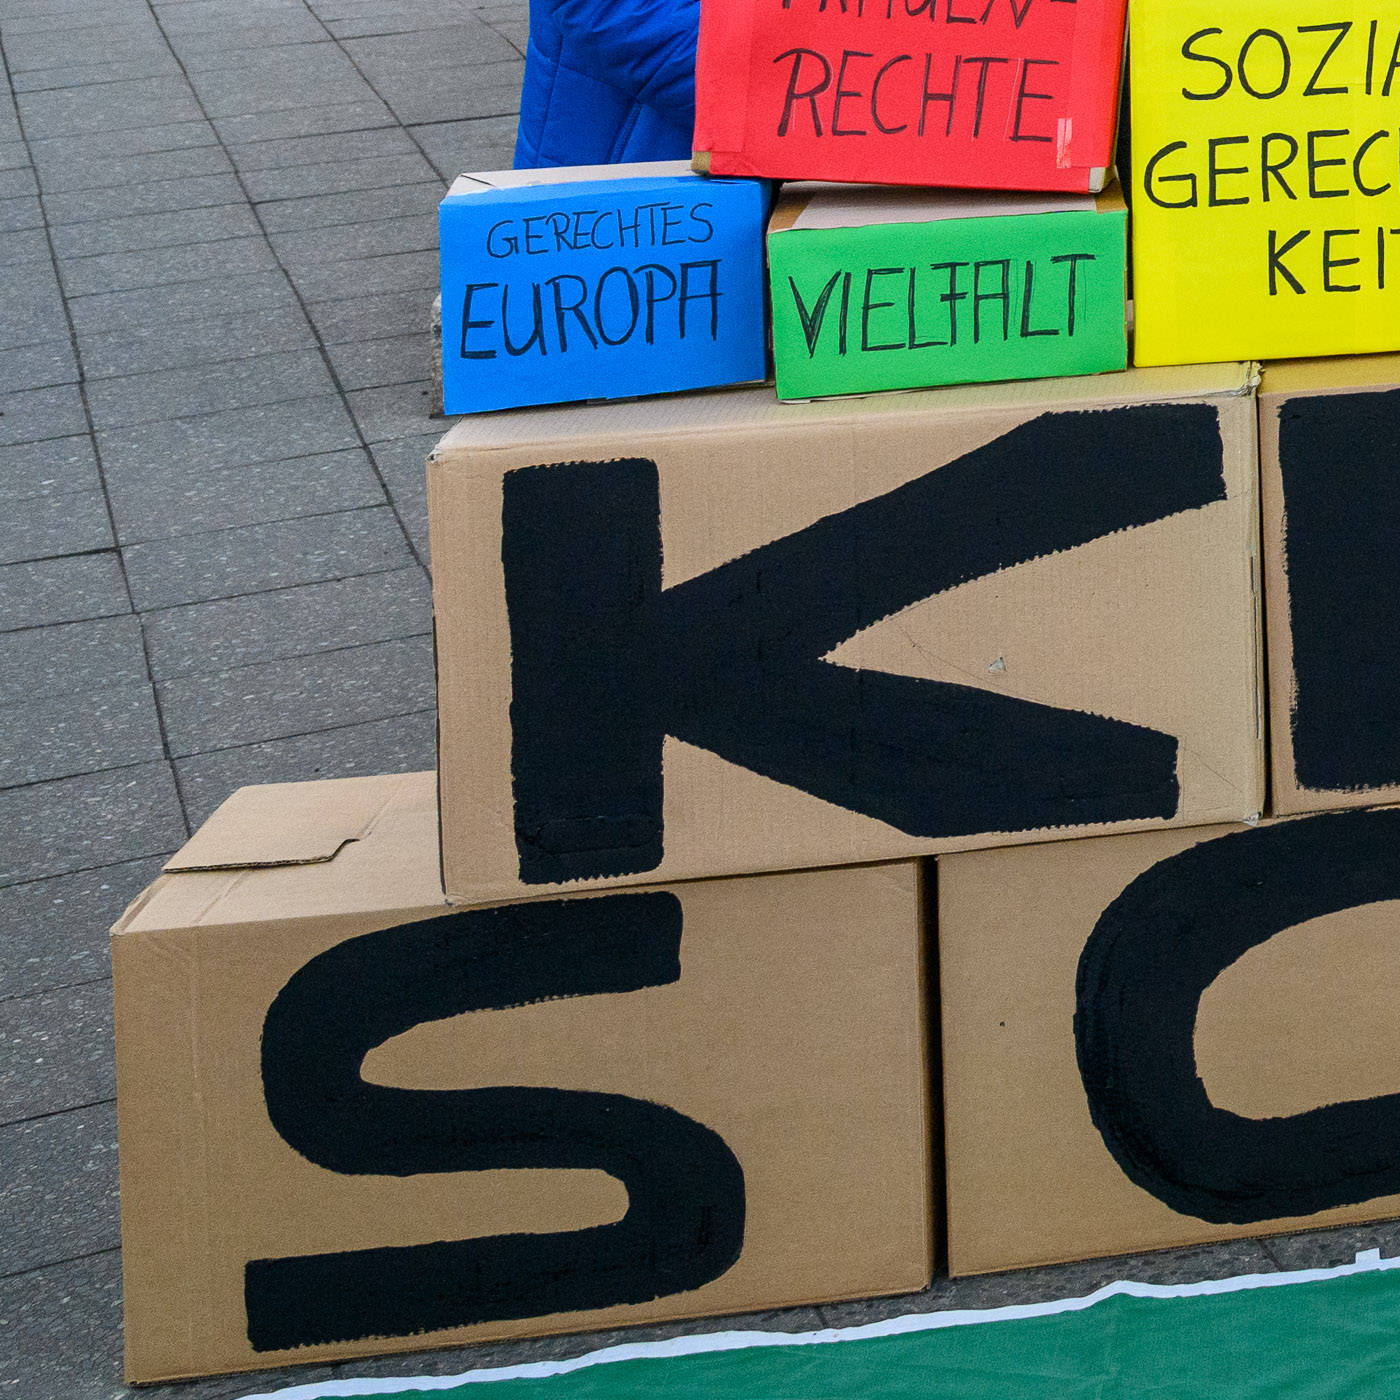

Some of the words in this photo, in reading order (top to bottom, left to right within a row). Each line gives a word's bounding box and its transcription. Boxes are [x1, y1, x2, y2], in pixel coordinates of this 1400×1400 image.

[773, 48, 1060, 142] RECHTE
[487, 203, 715, 259] GERECHTES
[460, 259, 723, 361] EUROPA
[789, 254, 1096, 359] VIELFALT
